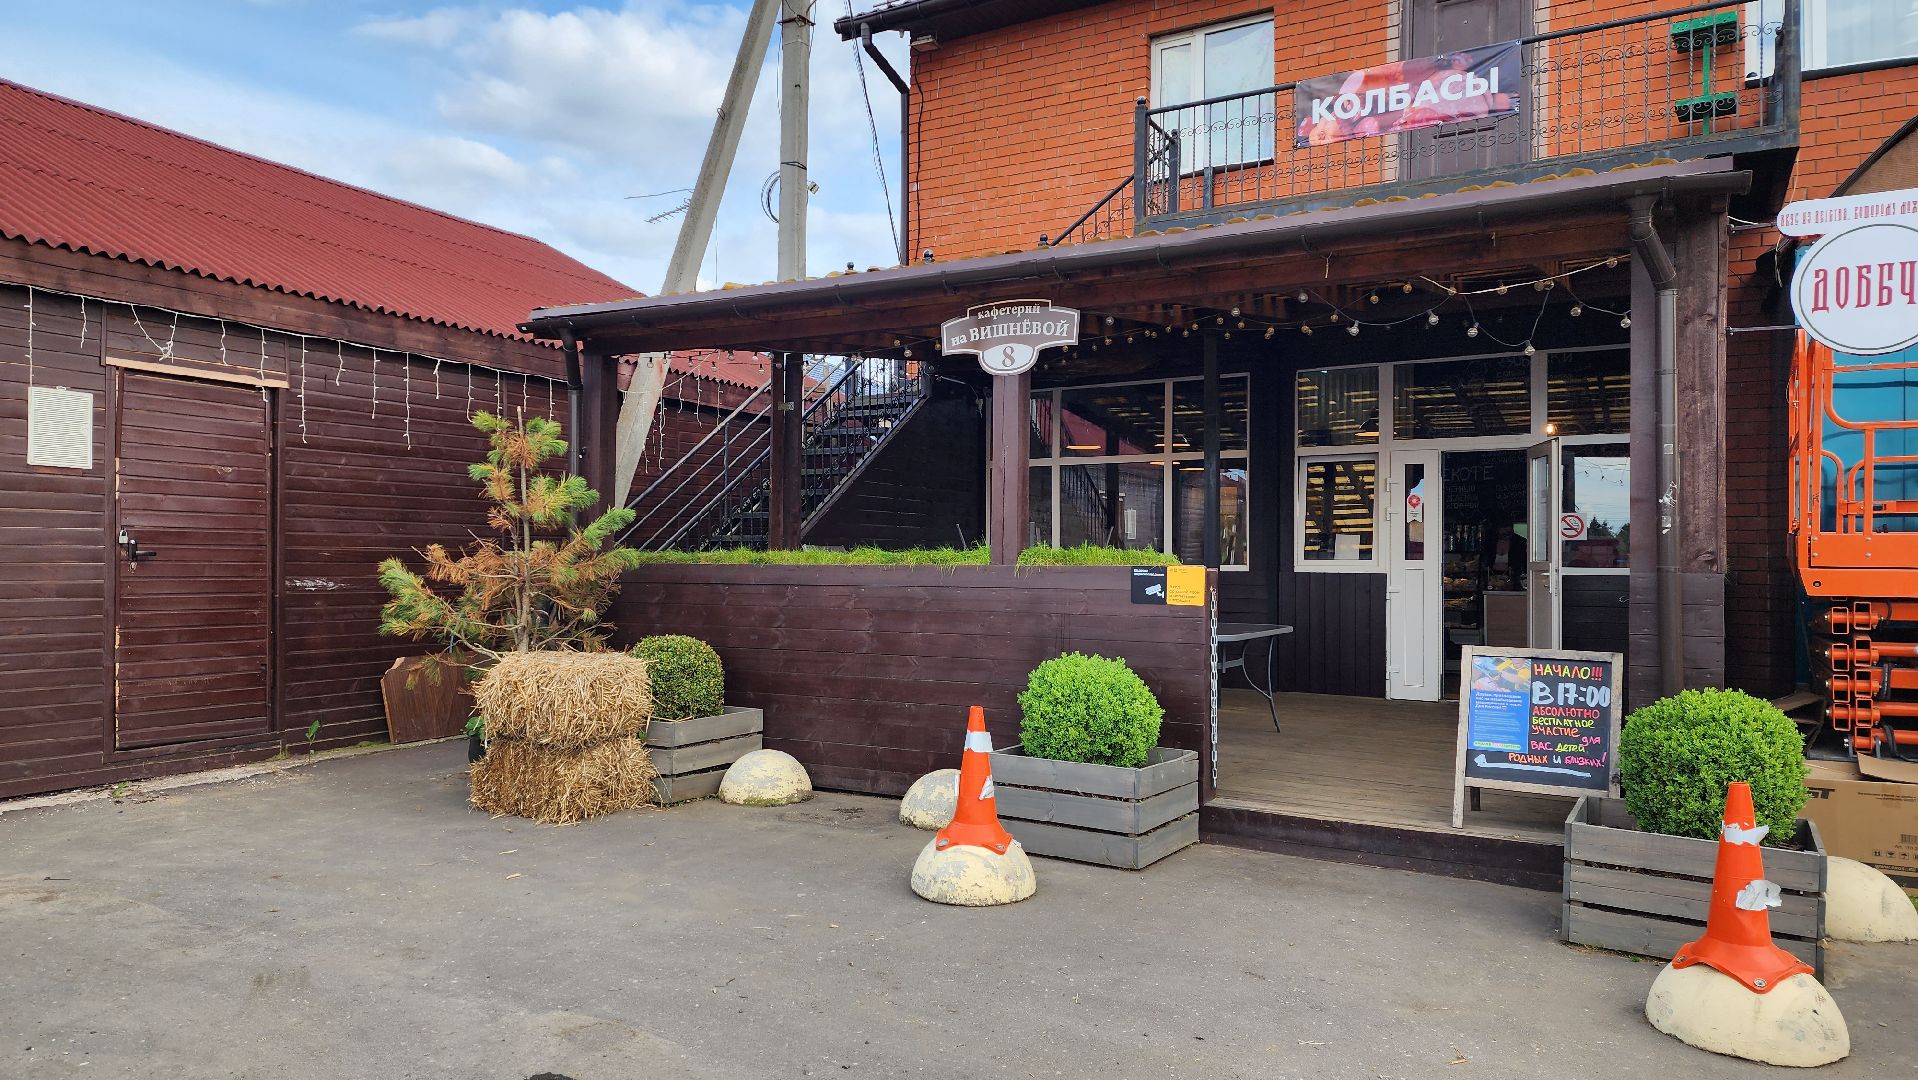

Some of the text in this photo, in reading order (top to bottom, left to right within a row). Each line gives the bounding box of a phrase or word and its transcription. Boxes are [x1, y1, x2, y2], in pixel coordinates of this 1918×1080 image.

[1310, 65, 1501, 125] КОЛБАСЫ
[977, 303, 1041, 321] кафетерий
[951, 319, 1070, 348] на ВИШНЁВОЙ
[1001, 345, 1015, 368] 8
[1533, 663, 1603, 682] НАЧАЛО!!!
[1531, 680, 1555, 705] В
[1557, 682, 1611, 708] 17:00
[1532, 706, 1600, 720] АБСОЛЮТНО
[1530, 740, 1553, 751] ВАС
[1508, 752, 1548, 764] РОДНЫХ
